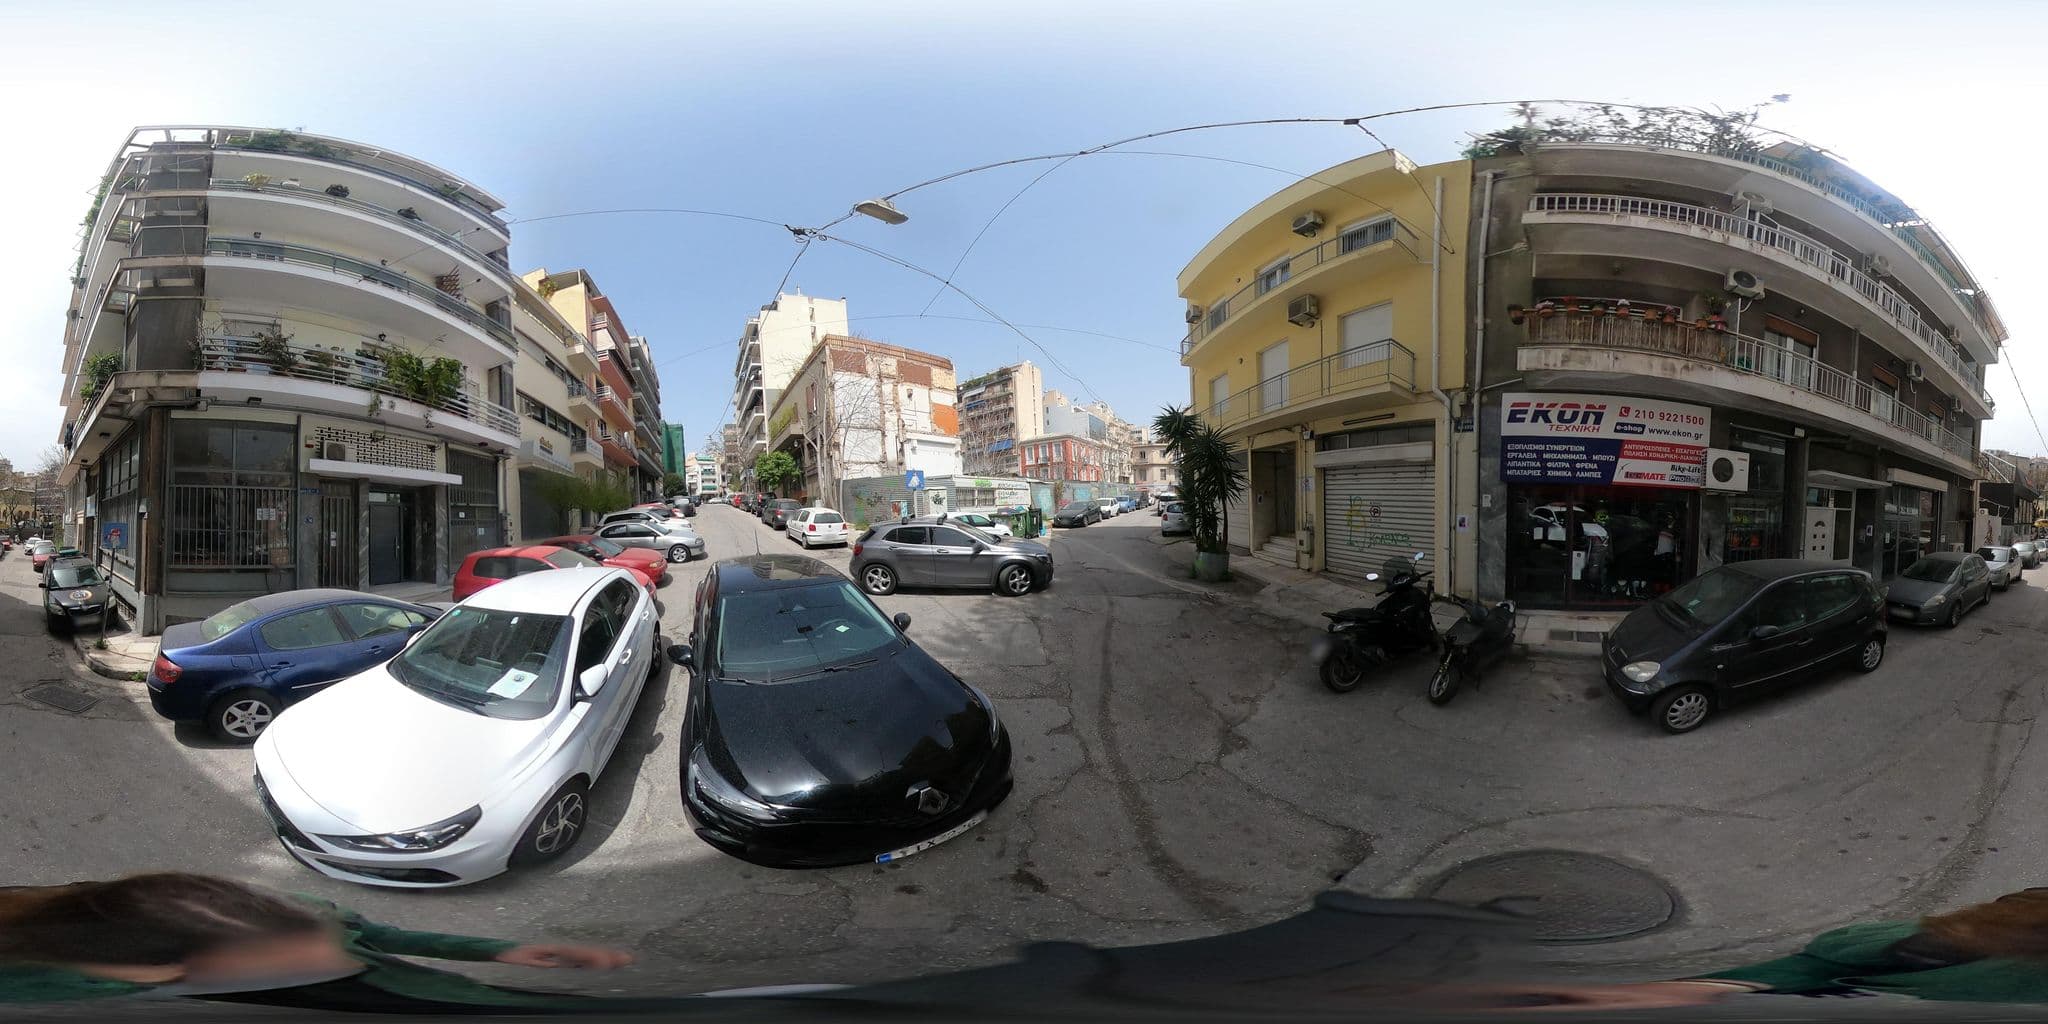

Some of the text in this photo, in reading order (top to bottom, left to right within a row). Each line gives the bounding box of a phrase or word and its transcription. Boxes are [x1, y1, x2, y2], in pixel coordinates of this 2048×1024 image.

[1634, 409, 1704, 425] 210 9221500
[1548, 424, 1601, 432] ΤΕΧΝΙΚΗ
[1648, 428, 1703, 440] www.ekon.gr
[1507, 460, 1541, 468] ΛΙΠΑΝΤΙΚΑ
